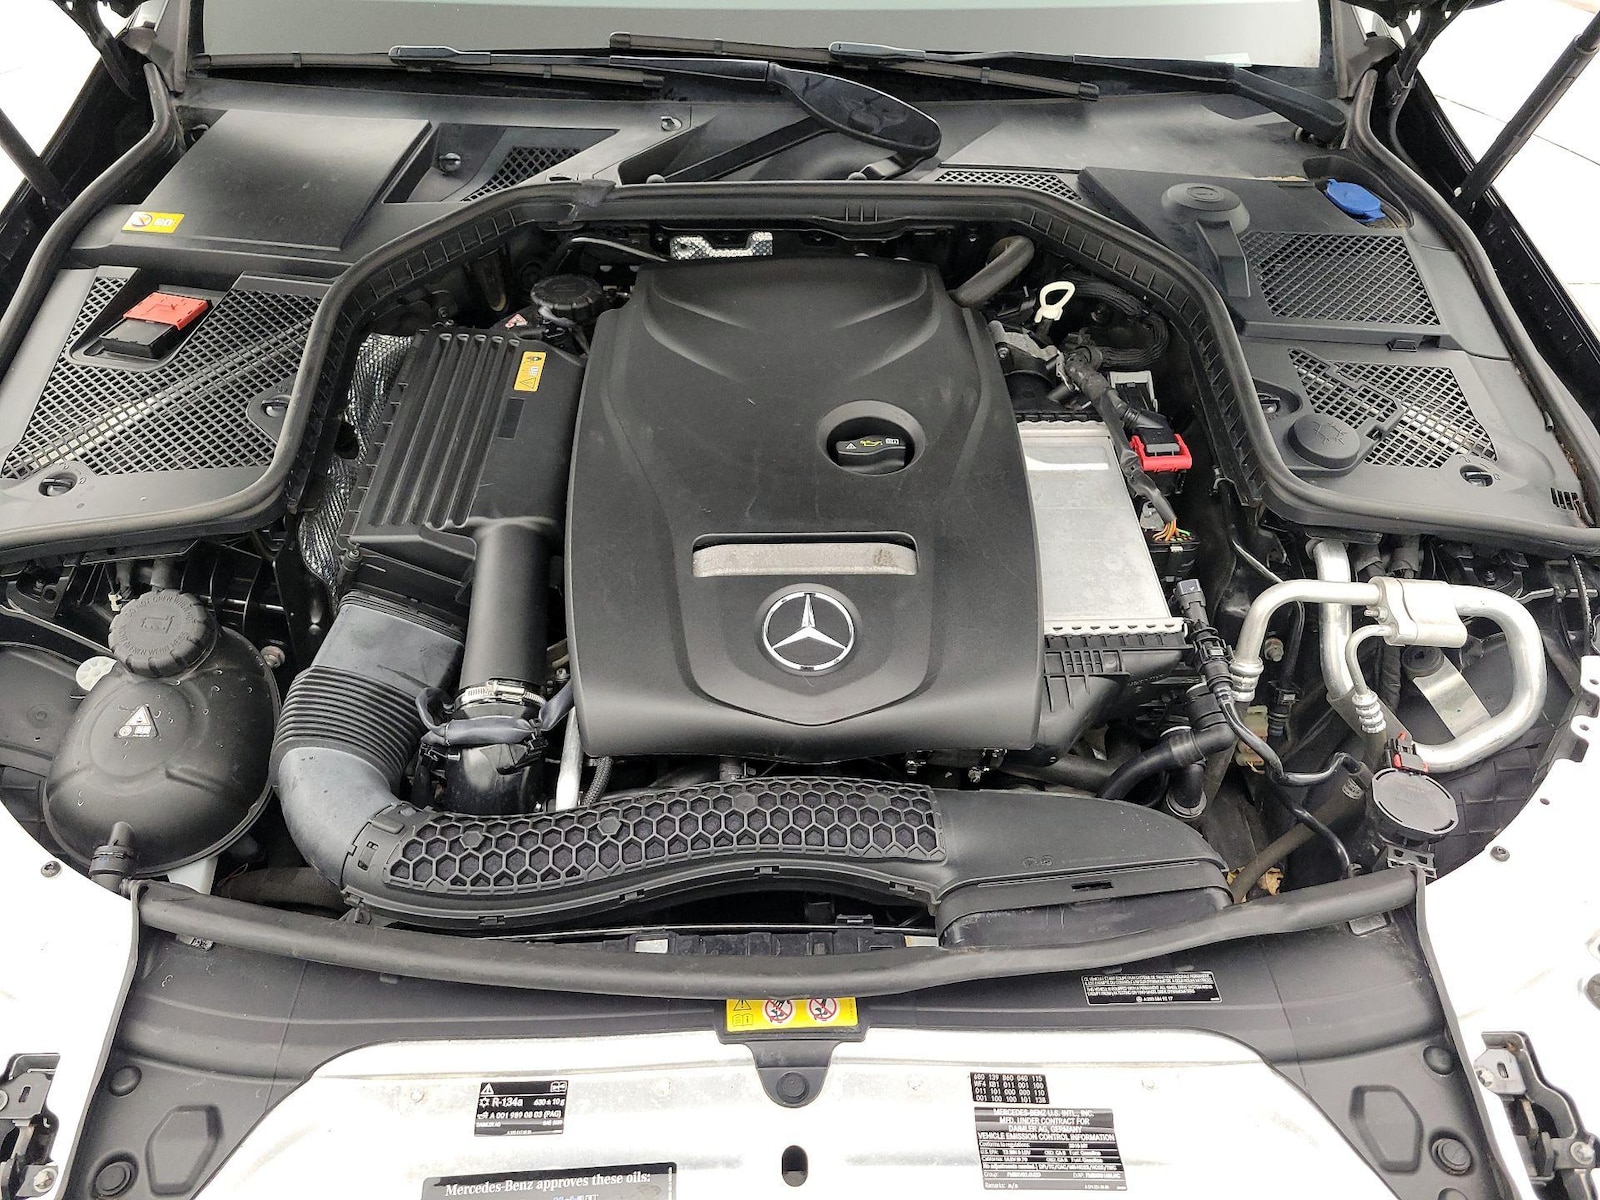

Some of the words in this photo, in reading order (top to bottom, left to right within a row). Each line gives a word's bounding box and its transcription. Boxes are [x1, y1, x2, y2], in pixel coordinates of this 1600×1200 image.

[491, 1097, 524, 1107] R-134a
[489, 1111, 496, 1119] A
[496, 1111, 509, 1119] 001
[533, 1110, 543, 1118] 03
[543, 1110, 562, 1119] (PAG)
[993, 1108, 1047, 1116] MERCEDES-BENZ
[1047, 1109, 1060, 1117] U.S.
[1017, 1116, 1040, 1124] UNDER
[1040, 1117, 1075, 1125] CONTRACT
[1076, 1117, 1090, 1125] FOR
[1007, 1124, 1037, 1132] DAIMLER
[1050, 1125, 1082, 1133] GERMANY
[977, 1131, 1005, 1140] VEHICLE
[1005, 1132, 1038, 1140] EMISSION
[1038, 1132, 1070, 1141] CONTROL
[1070, 1133, 1115, 1141] INFORMATION
[445, 1179, 533, 1197] Mercedes-Benz
[536, 1176, 591, 1192] approves
[591, 1172, 625, 1186] these
[626, 1171, 650, 1184] oils:
